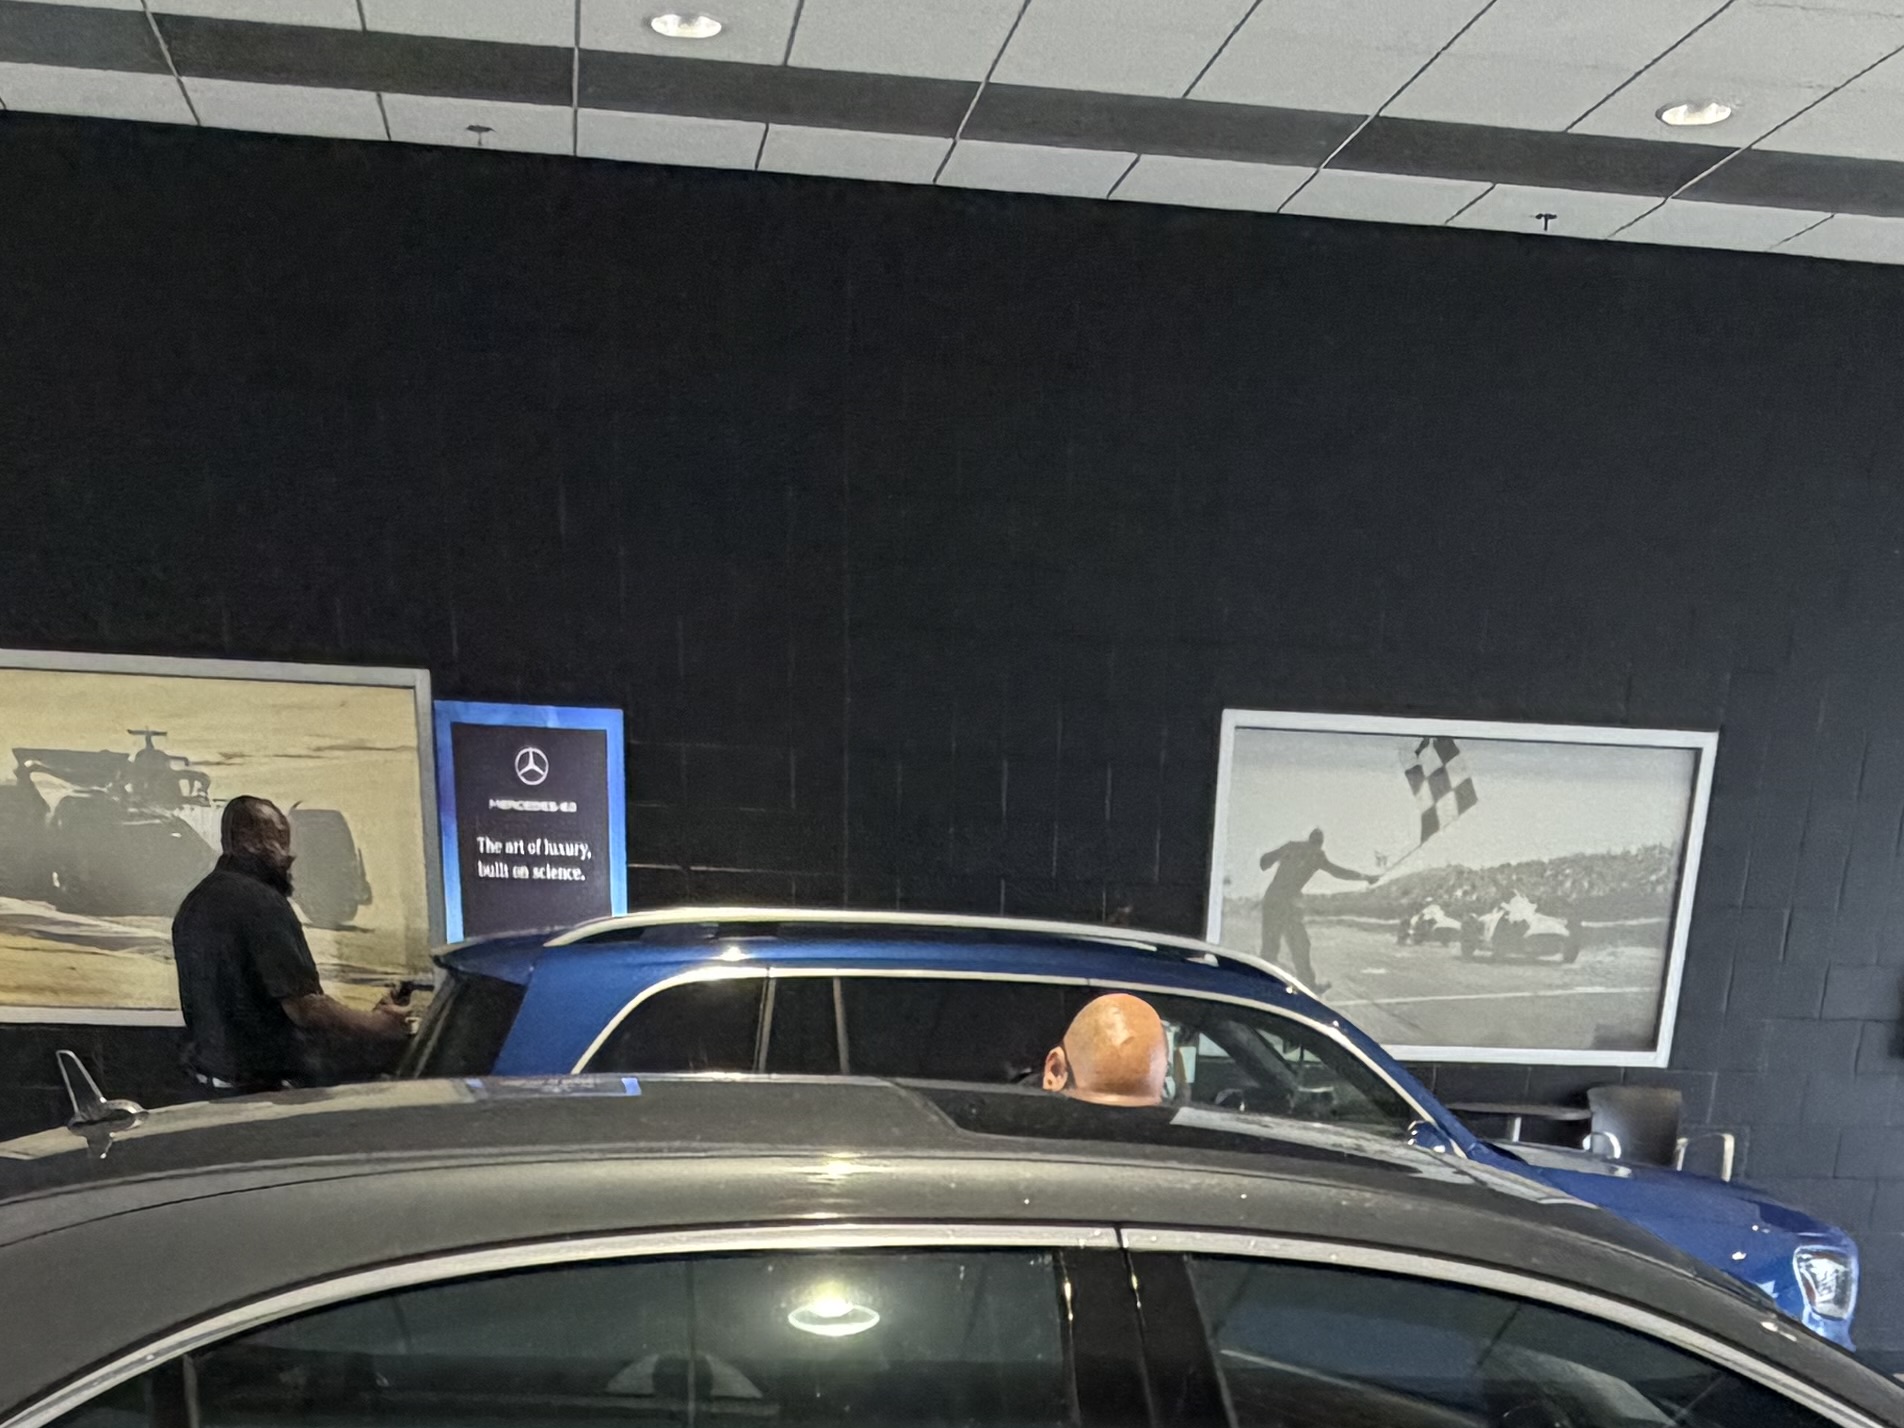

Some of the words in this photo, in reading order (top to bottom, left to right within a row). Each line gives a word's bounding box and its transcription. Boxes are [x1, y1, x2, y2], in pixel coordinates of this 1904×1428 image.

[477, 836, 502, 854] The
[505, 840, 524, 855] art
[527, 838, 542, 856] of
[544, 838, 592, 861] luxury,
[478, 860, 509, 878] built
[512, 866, 529, 879] on
[532, 863, 586, 881] science.
